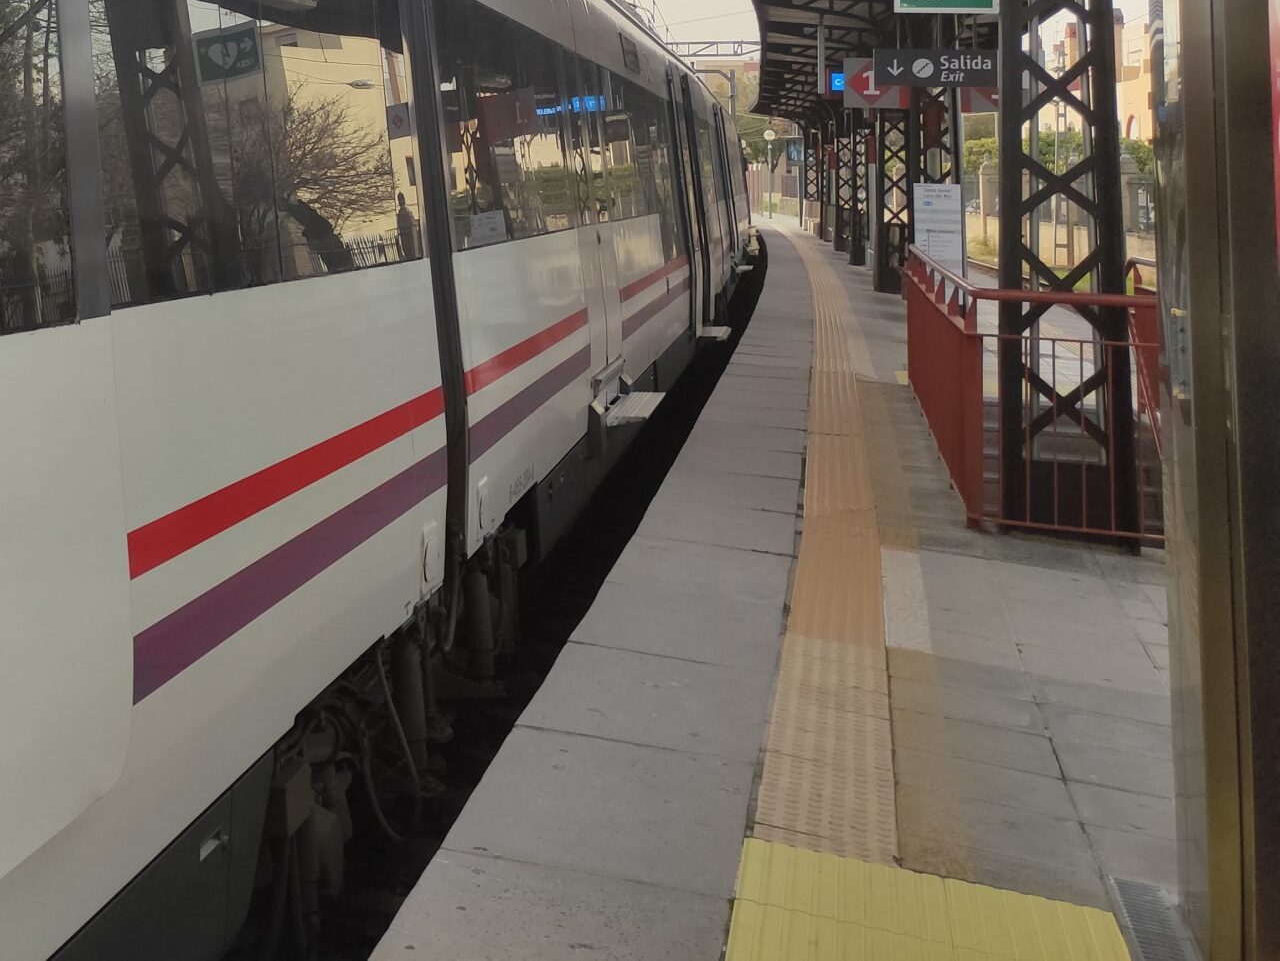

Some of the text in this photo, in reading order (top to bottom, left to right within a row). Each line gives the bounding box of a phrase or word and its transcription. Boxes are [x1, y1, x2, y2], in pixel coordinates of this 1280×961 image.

[940, 55, 992, 70] Salida
[834, 78, 844, 86] C-
[862, 70, 881, 95] 1
[940, 71, 965, 82] Exit
